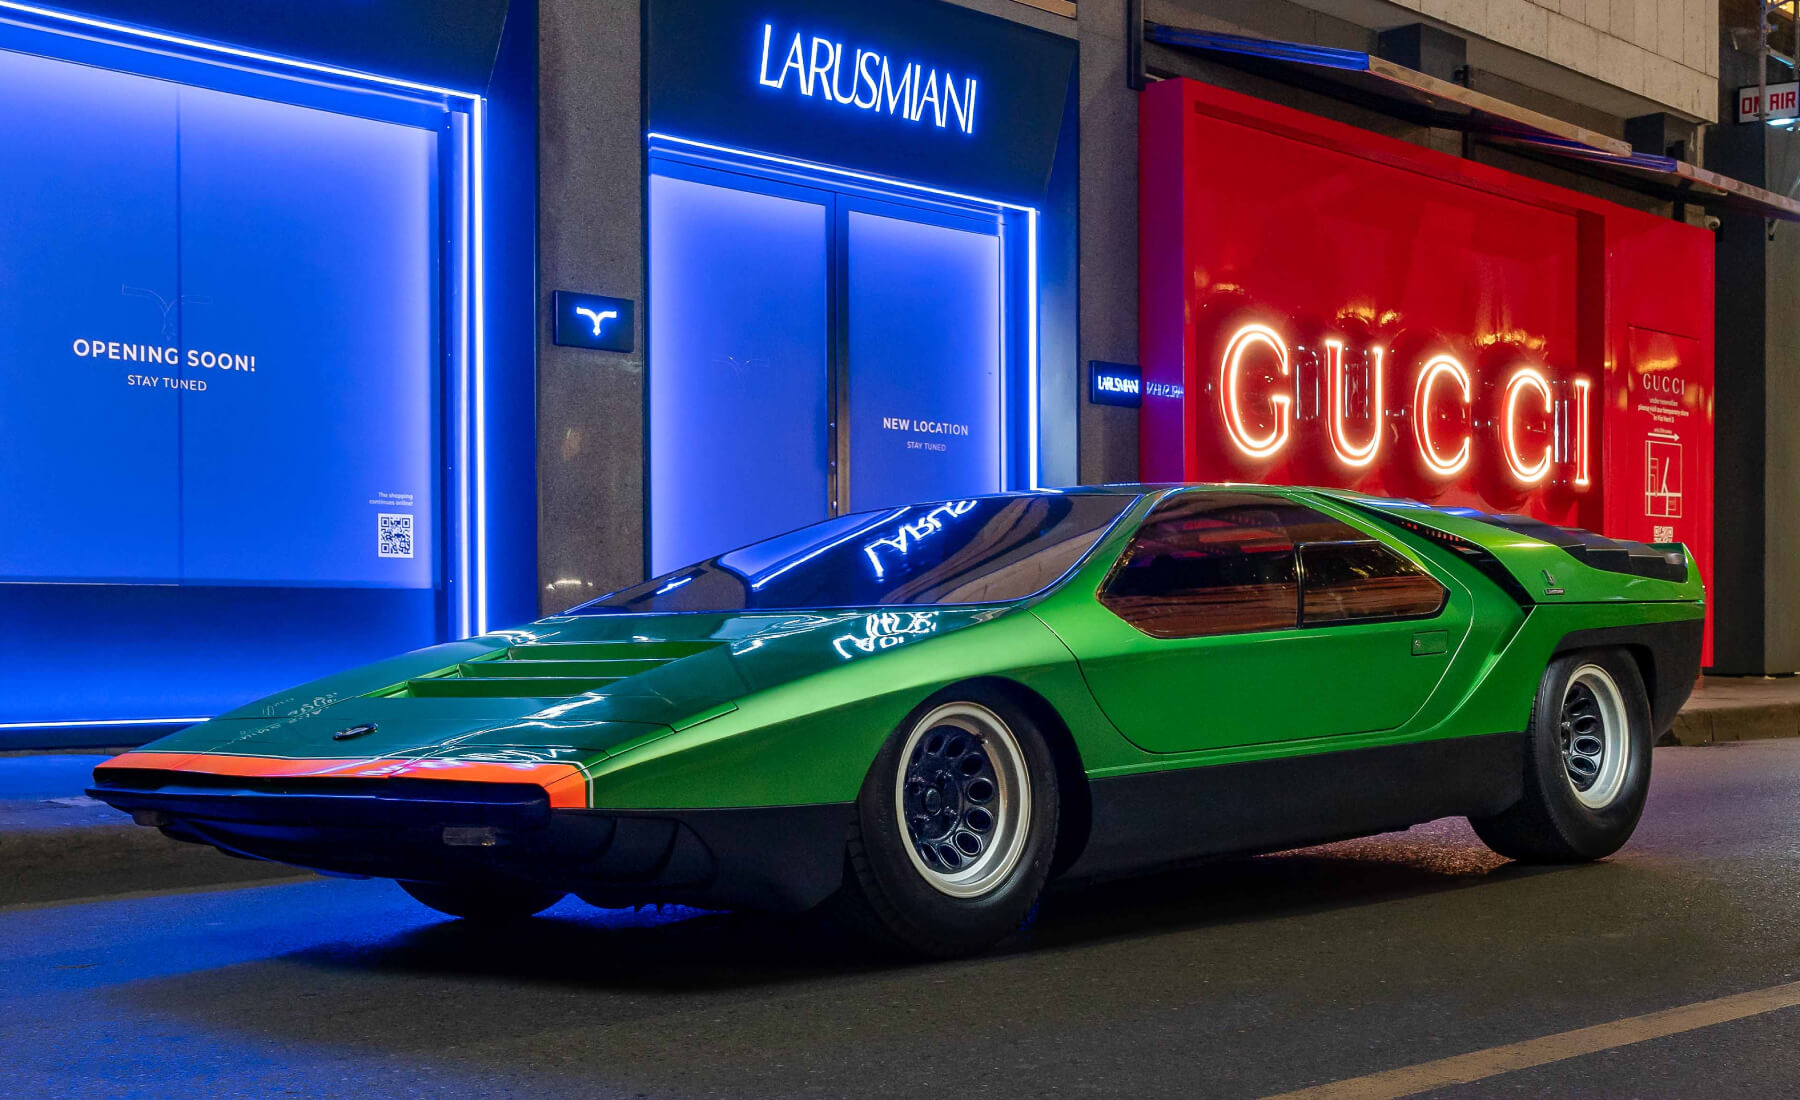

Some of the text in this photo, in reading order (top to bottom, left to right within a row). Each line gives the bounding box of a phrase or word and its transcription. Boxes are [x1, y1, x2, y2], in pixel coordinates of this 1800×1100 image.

[759, 23, 977, 134] LARUSMIANI
[1769, 91, 1796, 111] AIR
[73, 338, 256, 372] OPENING SOON!
[127, 374, 207, 392] STAY TUNED
[1642, 373, 1685, 395] GUCCI
[1220, 324, 1591, 486] GUCCI
[883, 417, 969, 436] NEW LOCATION
[906, 441, 946, 452] STAY TUNED
